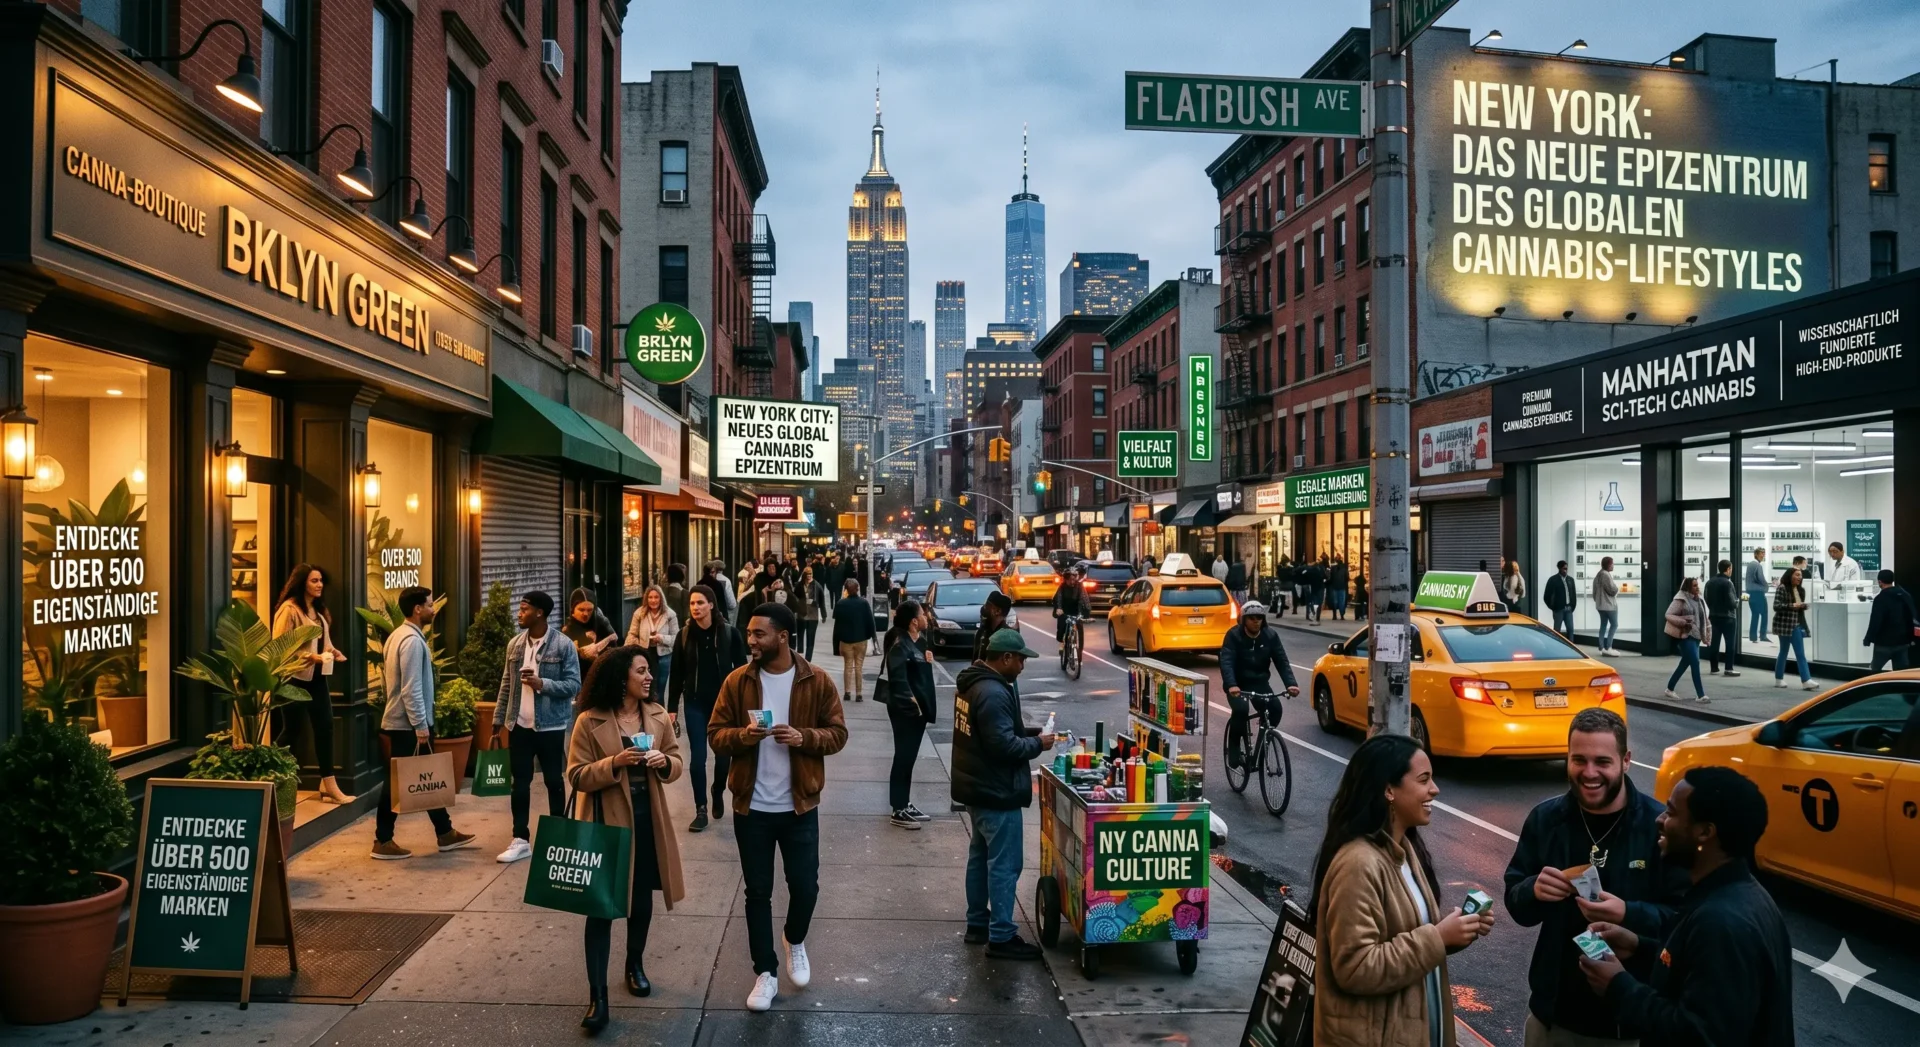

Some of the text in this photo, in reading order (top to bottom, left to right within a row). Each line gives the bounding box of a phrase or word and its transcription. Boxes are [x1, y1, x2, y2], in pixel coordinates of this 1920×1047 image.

[1137, 81, 1350, 127] FLATBUSH AVE
[1453, 79, 1652, 140] NEW YORK:
[1453, 133, 1808, 200] DAS NEUE EPIZENTRUM
[65, 145, 207, 237] CANNA-BOUTIQUE
[1453, 183, 1684, 238] DES GLOBALEN
[1452, 232, 1803, 293] CANNABIS-LIFESTYLES
[224, 205, 430, 356] BKLYN GREEN
[1798, 308, 1899, 343] WISSENSCHAFTLICH
[638, 335, 692, 348] BRLYN
[1820, 331, 1876, 355] FUNDIERTE
[637, 349, 693, 362] GREEN
[1796, 344, 1903, 377] HIGH-END-PRODUKTE
[1602, 336, 1756, 399] MANHATTAN
[1522, 388, 1552, 404] PREMIUM
[1602, 376, 1756, 422] SCI-TECH CANNABIS
[724, 403, 834, 425] NEW YORK CITY:
[1502, 417, 1533, 433] CANNABIS
[728, 422, 829, 442] NEUES GLOBAL
[744, 440, 814, 459] CANNABIS
[1122, 439, 1172, 453] VIELFALT
[735, 458, 823, 477] EPIZENTRUM
[1123, 456, 1173, 469] & KULTUR
[1297, 472, 1365, 495] LEGALE MARKEN
[56, 525, 140, 551] ENTDECKE
[381, 548, 422, 568] OVER 500
[50, 552, 144, 590] ÜBER 500
[384, 569, 419, 590] BRANDS
[1419, 582, 1458, 599] CANNABIS
[33, 588, 159, 625] EIGENSTÄNDIGE
[64, 623, 132, 655] MARKEN
[419, 772, 434, 782] NY
[488, 763, 503, 778] NY
[161, 816, 247, 839] ENTDECKE
[1099, 829, 1200, 854] NY CANNA
[151, 838, 250, 871] ÜBER 500
[546, 845, 603, 869] GOTHAM
[548, 864, 592, 886] GREEN
[1106, 856, 1192, 882] CULTURE
[146, 872, 249, 893] EIGENSTÄNDIGE
[160, 895, 230, 917] MARKEN
